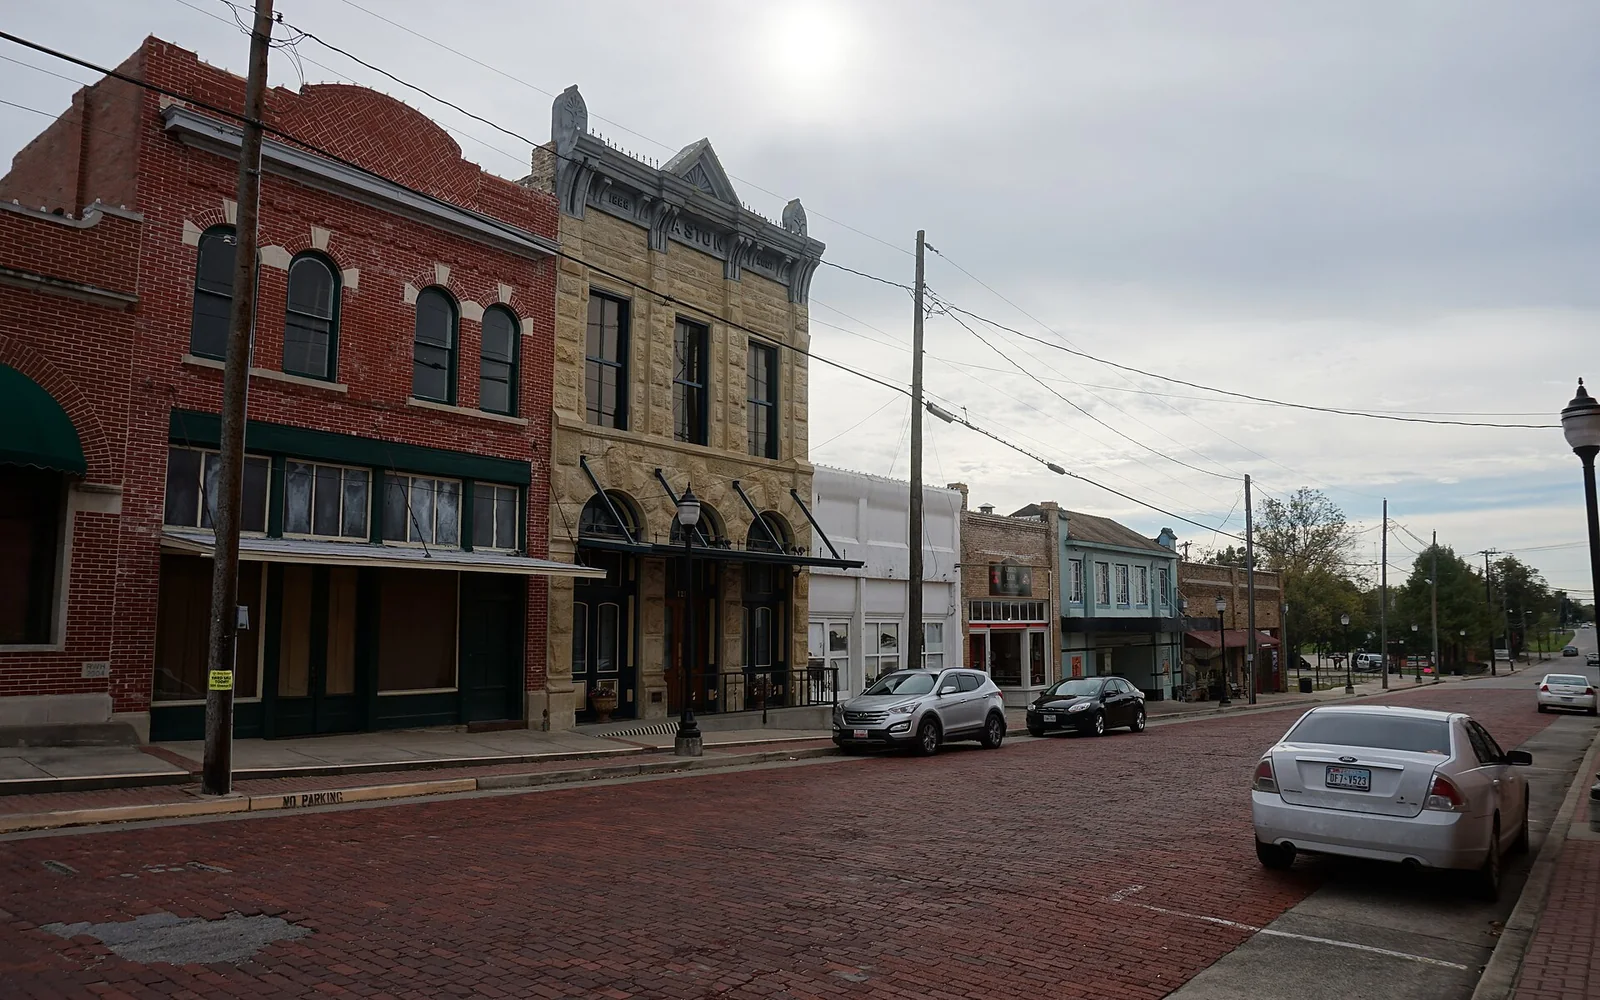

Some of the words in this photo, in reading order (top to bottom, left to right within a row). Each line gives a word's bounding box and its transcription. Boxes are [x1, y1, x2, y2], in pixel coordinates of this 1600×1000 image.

[671, 218, 723, 252] ASTON
[283, 795, 297, 808] NO
[301, 791, 344, 808] PARKING
